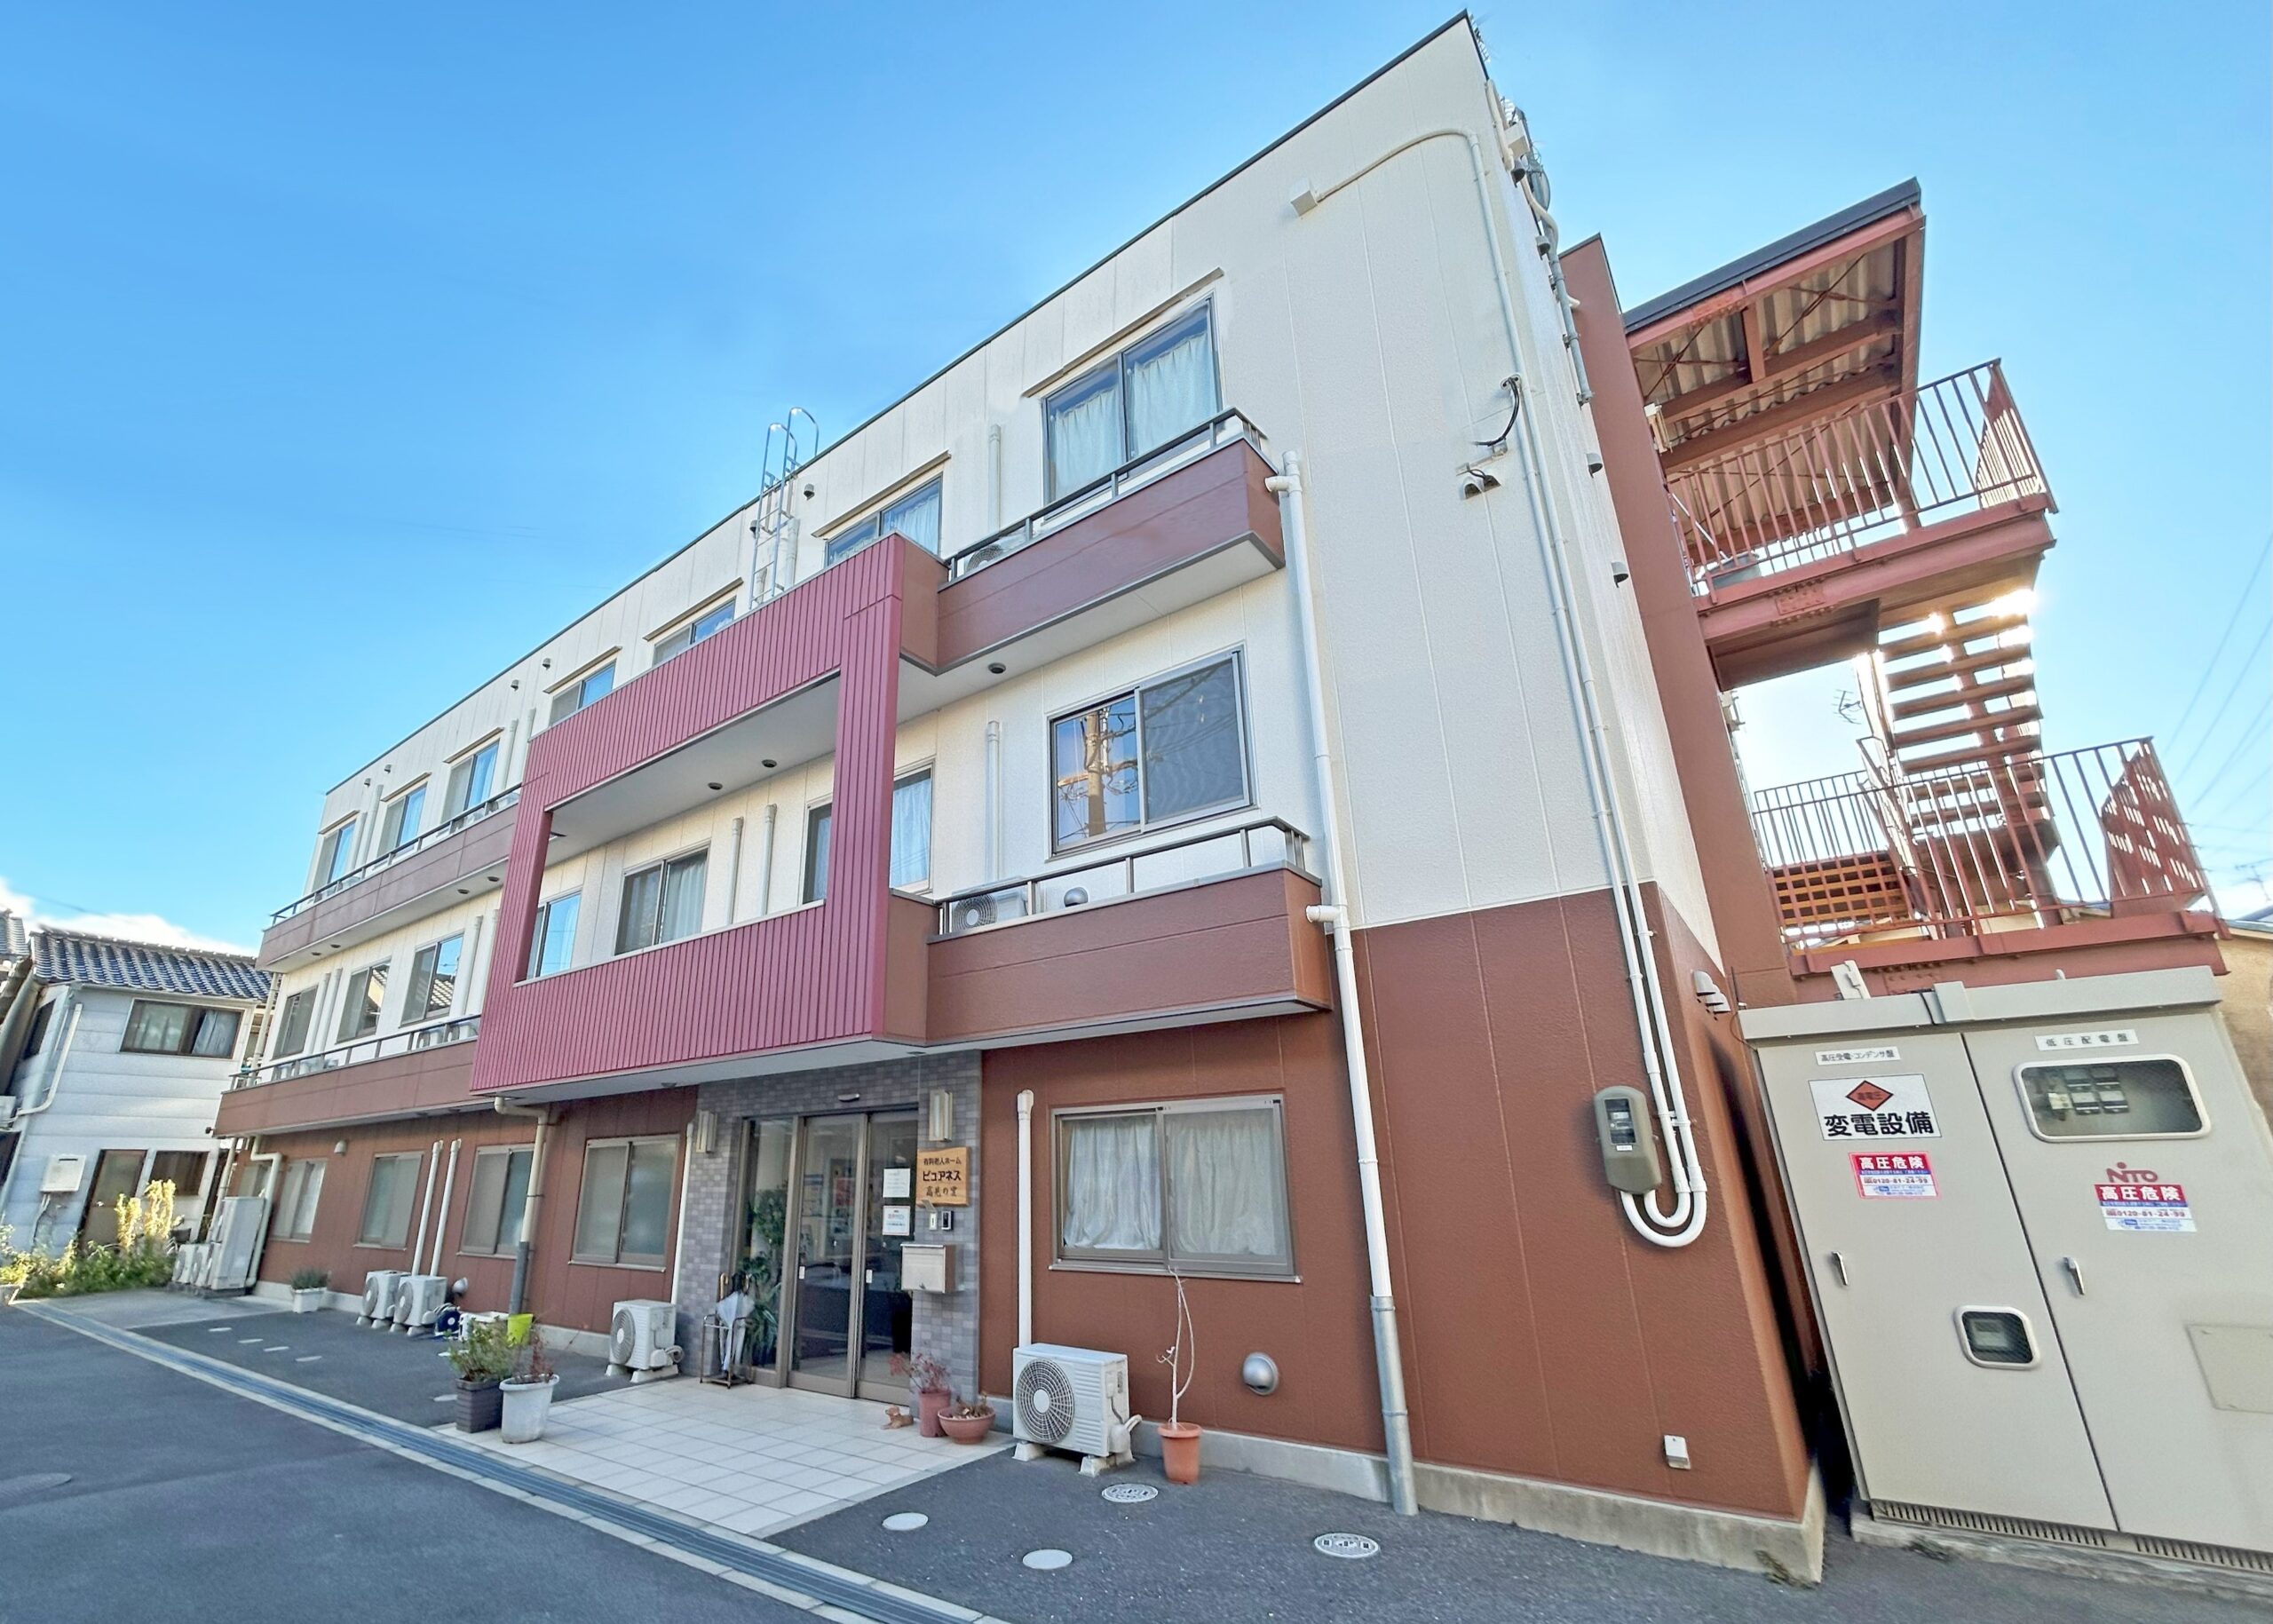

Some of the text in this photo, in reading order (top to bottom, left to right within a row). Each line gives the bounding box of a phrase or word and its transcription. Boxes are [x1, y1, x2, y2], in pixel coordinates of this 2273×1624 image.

[2046, 1033, 2128, 1047] 低圧配電盤
[1824, 1111, 1934, 1137] 変電設備
[1858, 1156, 1924, 1169] 高圧危険
[2099, 1186, 2182, 1200] 高圧危険
